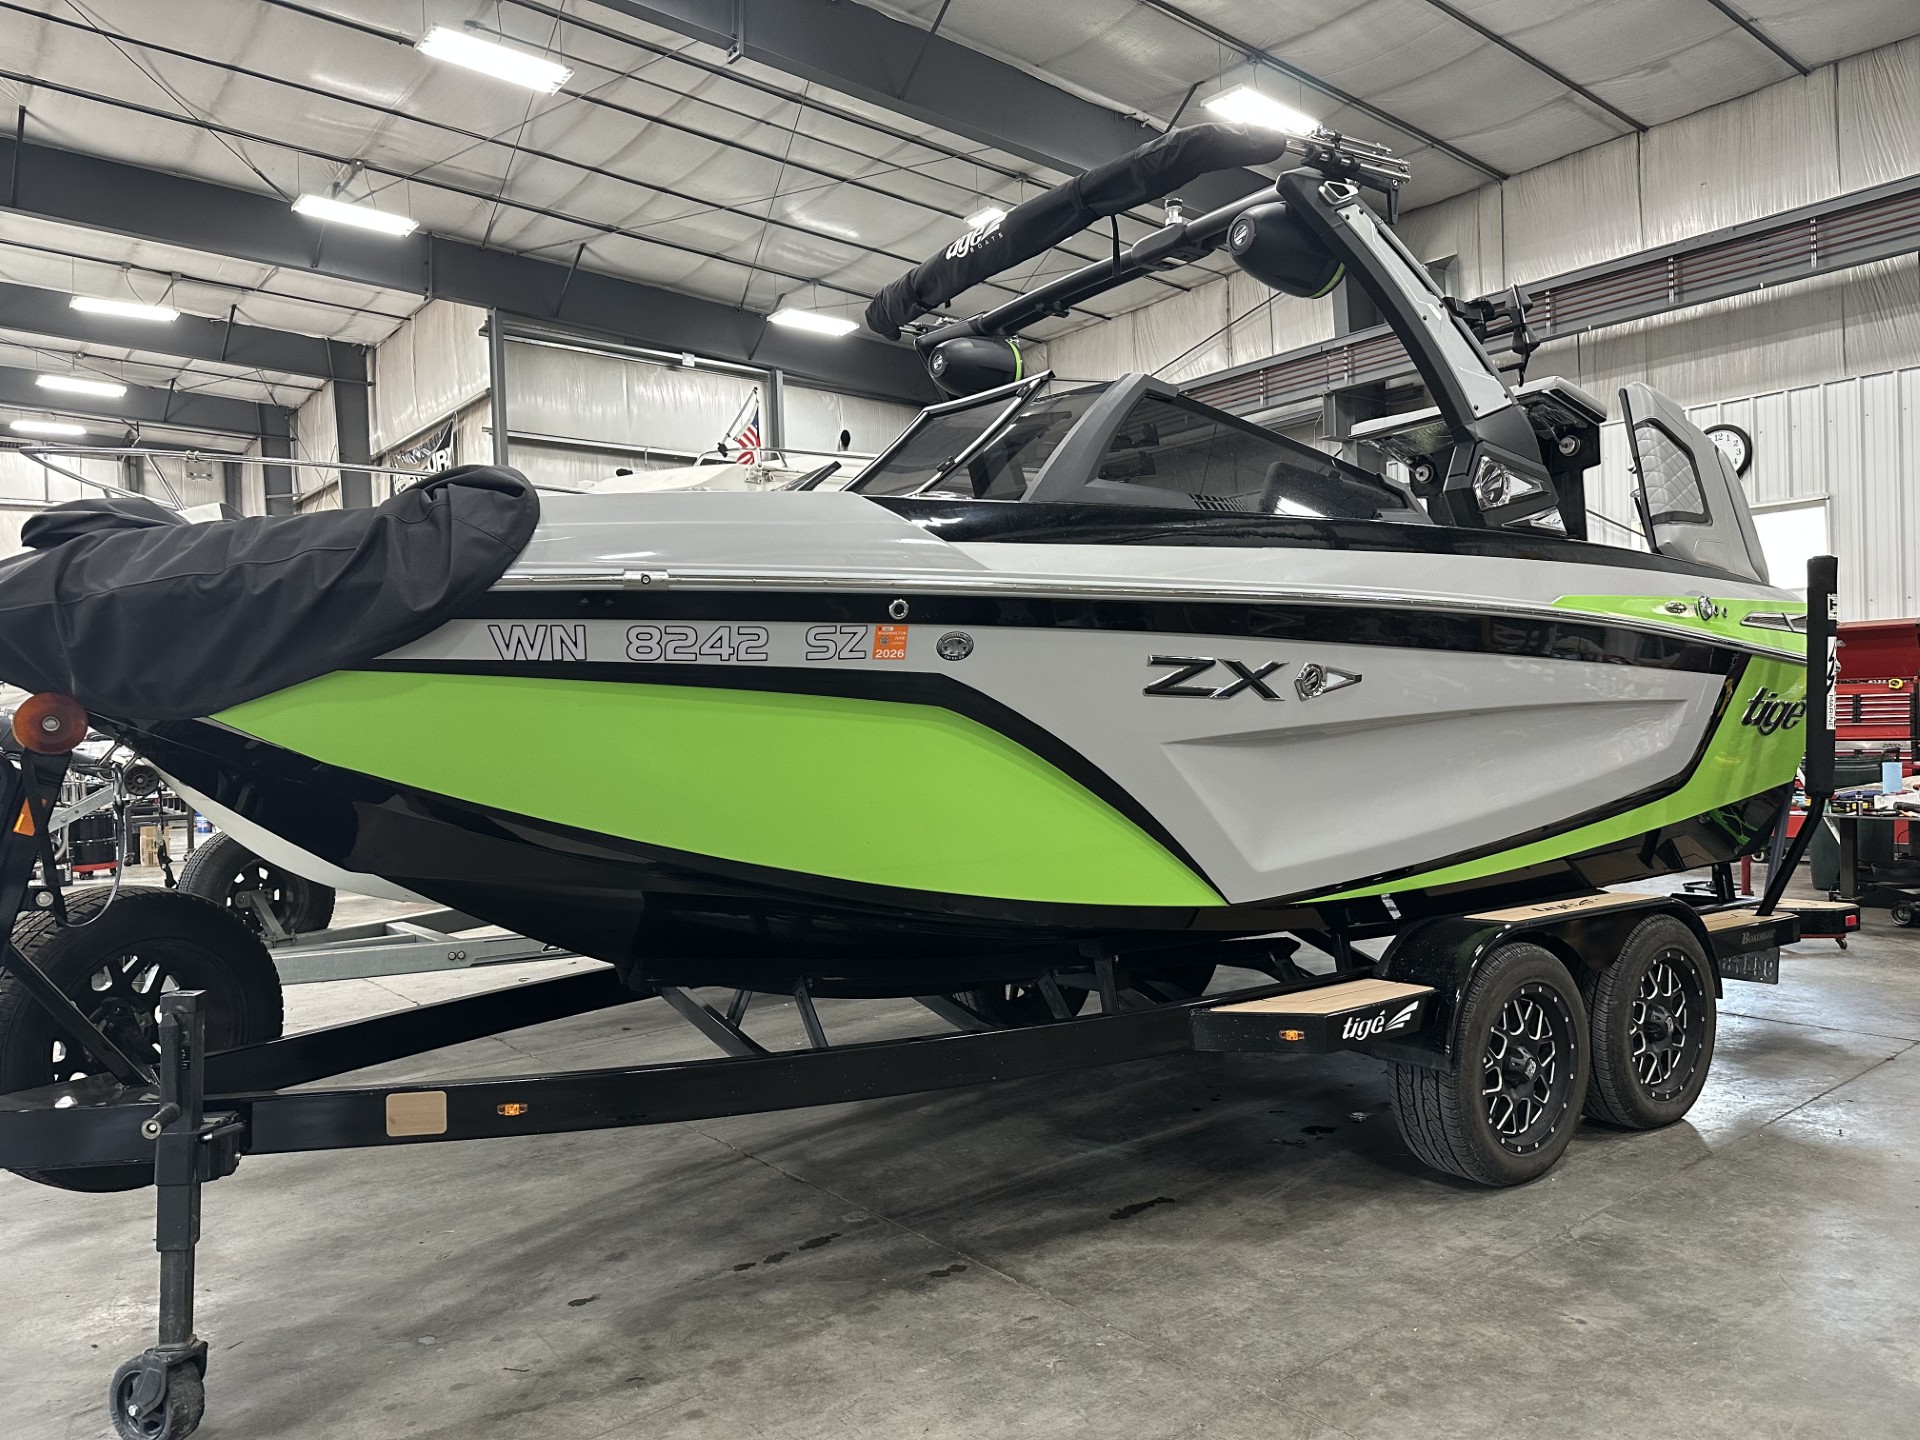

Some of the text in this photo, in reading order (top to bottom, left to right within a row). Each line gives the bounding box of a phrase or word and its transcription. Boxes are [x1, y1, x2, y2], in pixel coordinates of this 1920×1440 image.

[969, 232, 1004, 253] BOATS
[1714, 433, 1723, 441] 12
[487, 624, 868, 661] WN 8242 SZ
[875, 649, 904, 658] 2026
[1142, 654, 1290, 701] ZX
[1342, 1009, 1386, 1041] tigé
